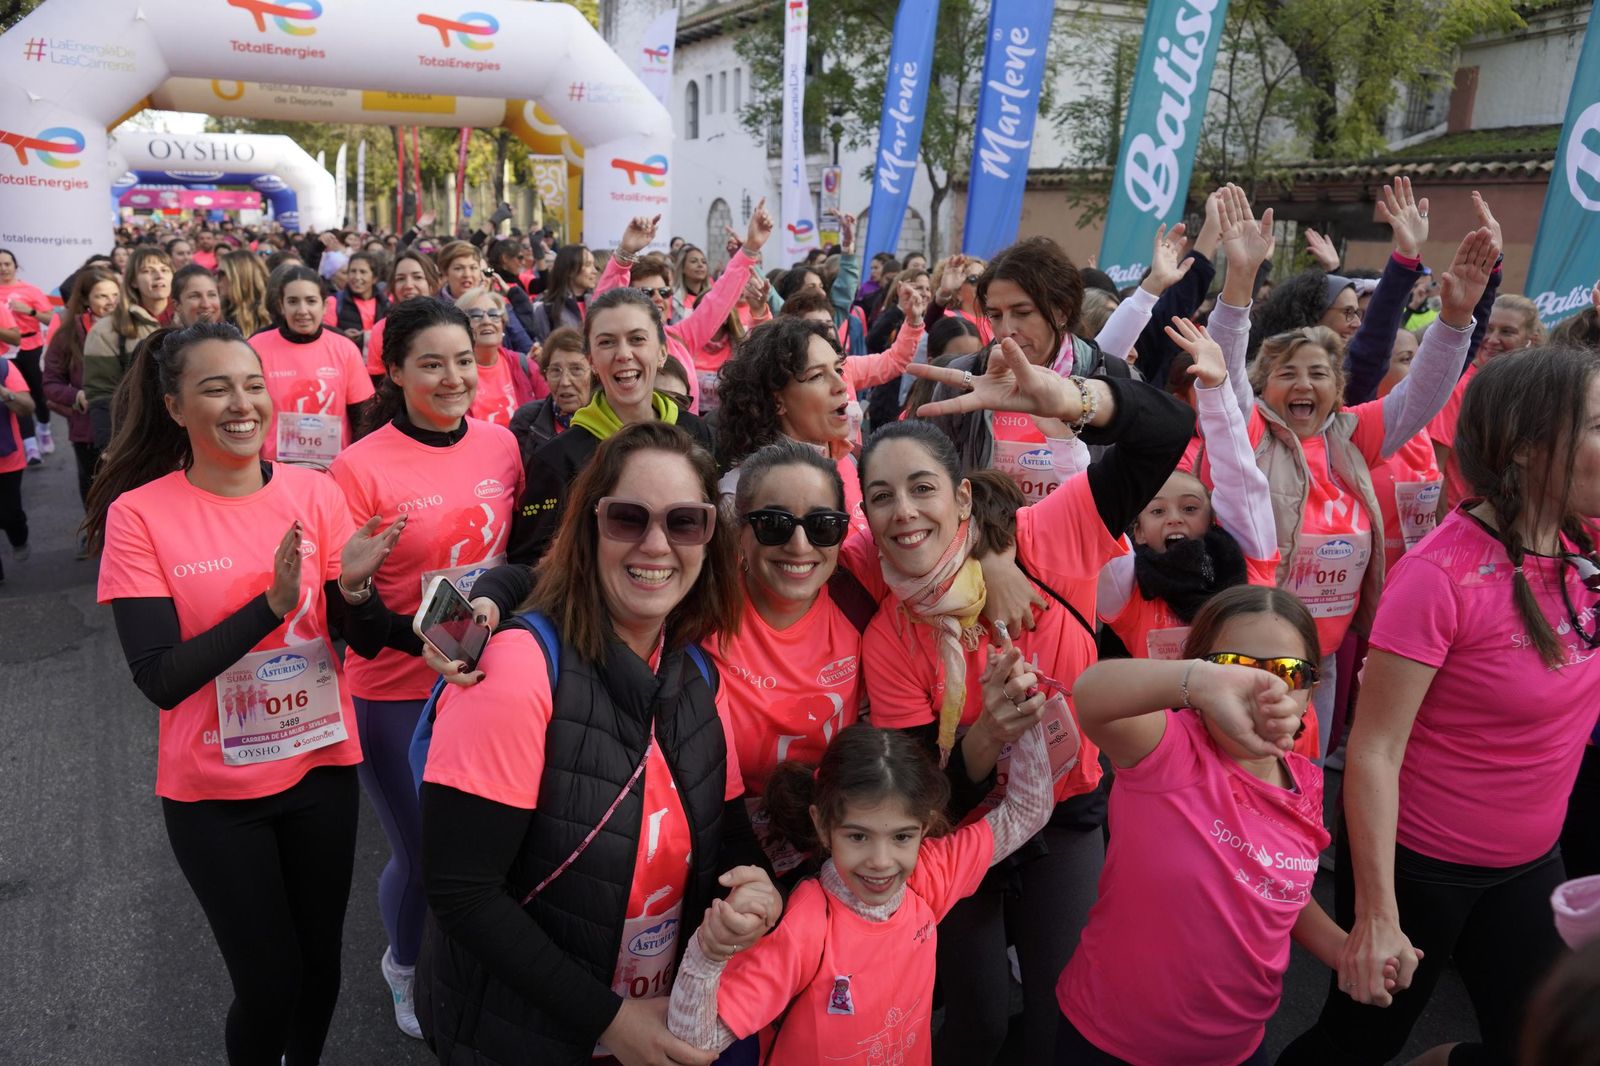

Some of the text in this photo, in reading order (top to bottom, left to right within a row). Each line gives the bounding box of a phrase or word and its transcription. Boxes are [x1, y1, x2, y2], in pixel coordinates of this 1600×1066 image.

[229, 40, 326, 60] TotalEnergies
[417, 55, 501, 72] TotalEnergies
[274, 96, 334, 107] de Deportes
[980, 26, 1036, 179] Marlene
[1124, 0, 1219, 220] Batis
[879, 61, 918, 194] Marlene
[148, 138, 255, 162] OYSHO
[0, 173, 89, 191] TotalEnergies
[610, 192, 668, 204] TotalEnergie
[2, 233, 93, 246] totalenergies.es
[1533, 282, 1598, 316] Batis
[994, 415, 1028, 427] YSHO
[298, 437, 322, 447] 016
[1022, 456, 1052, 466] ASTURIA
[1021, 481, 1059, 496] 016
[397, 495, 443, 513] OYSHO
[173, 556, 233, 577] OYSHO
[1316, 569, 1347, 584] 016
[261, 662, 305, 678] ASTURIANA
[820, 664, 857, 684] ASTURIAN
[266, 690, 308, 715] 016
[242, 735, 270, 744] CARRERA
[271, 732, 279, 740] DE
[280, 730, 288, 738] LA
[309, 718, 327, 729] SEVILLA
[280, 717, 299, 729] 3489
[239, 745, 280, 758] OYSHO
[633, 930, 676, 951] ASTURIAN
